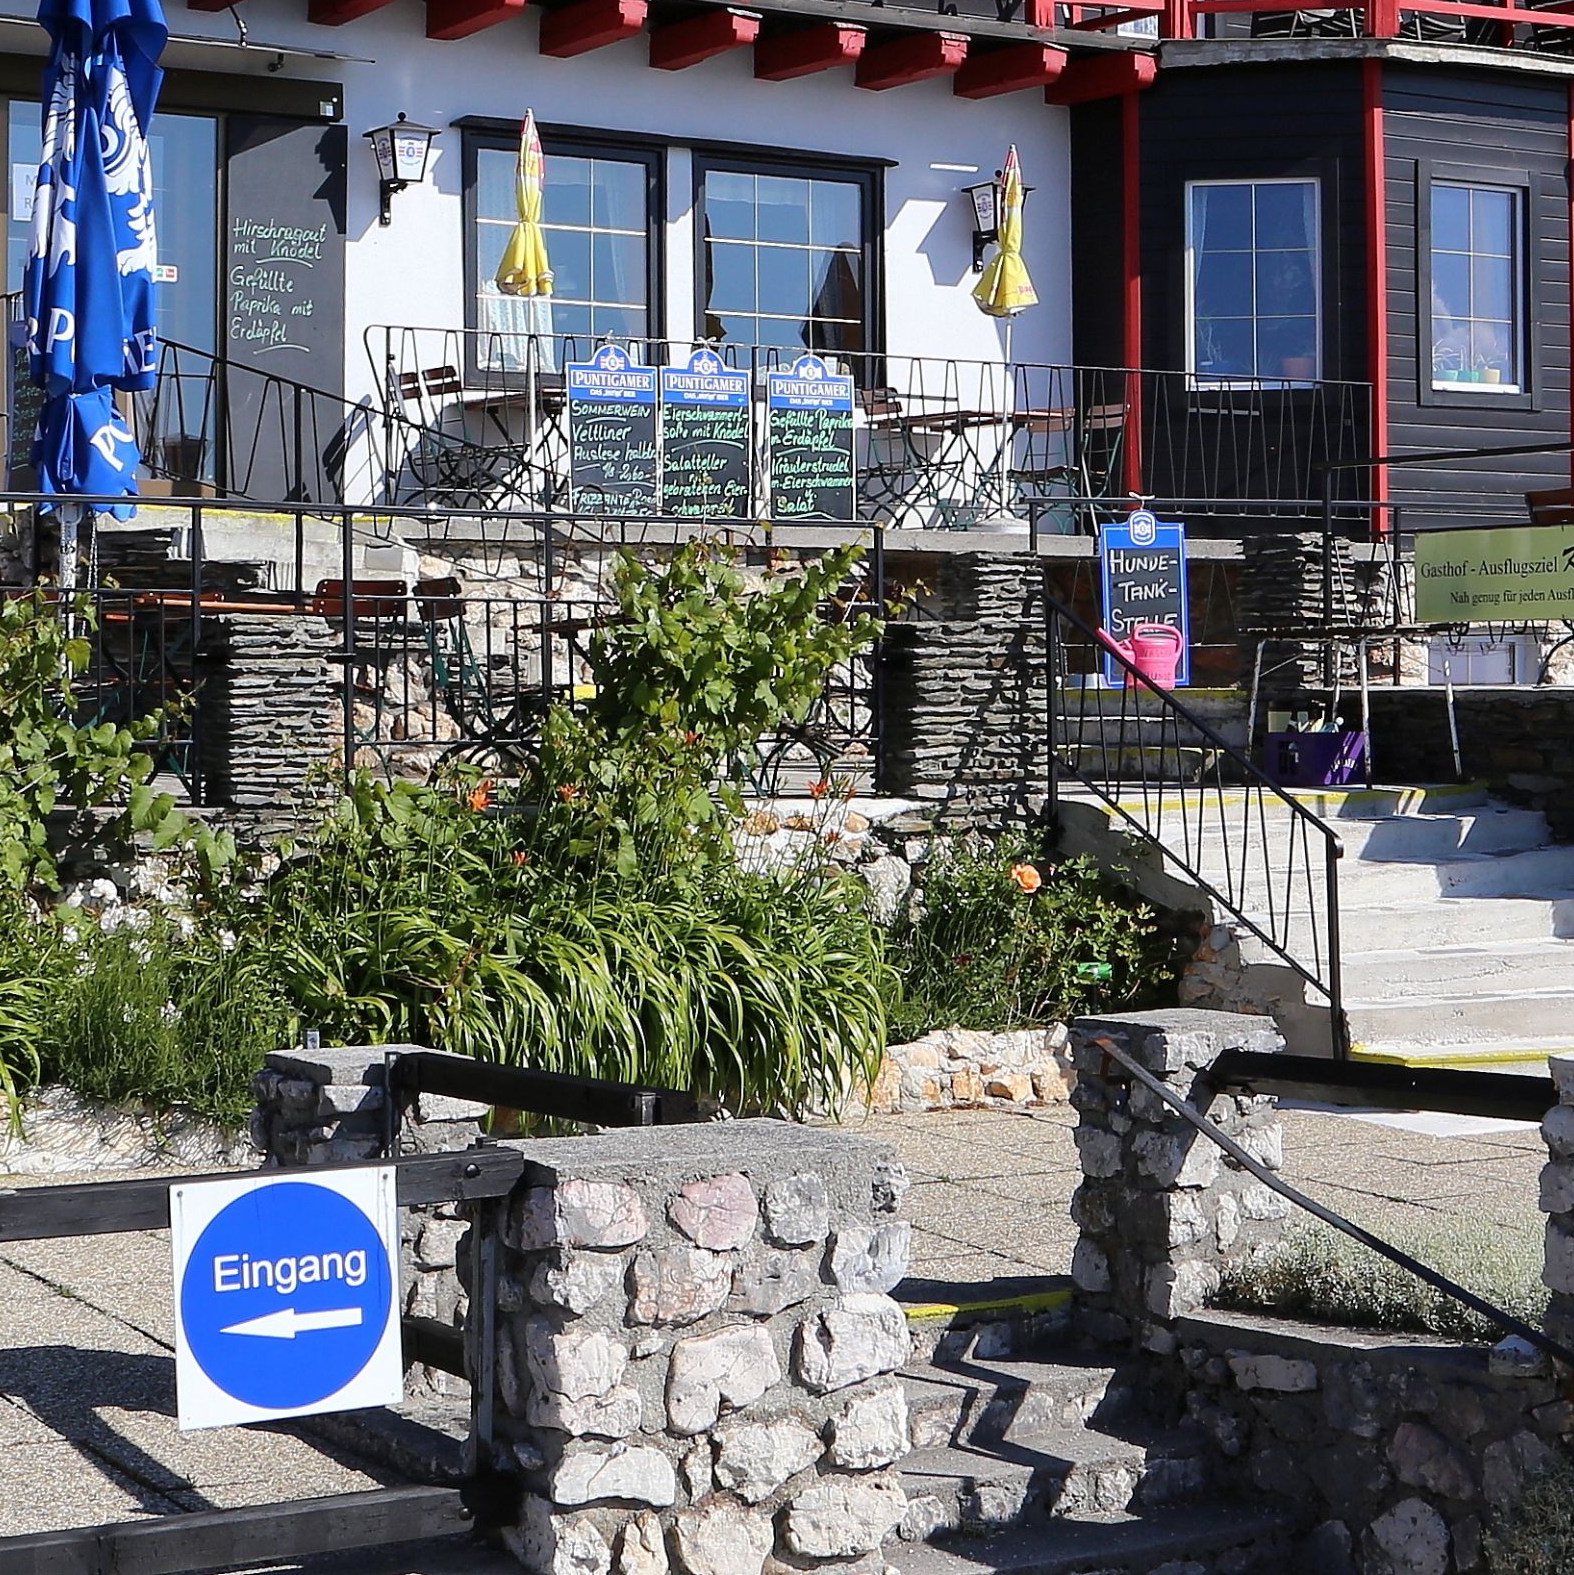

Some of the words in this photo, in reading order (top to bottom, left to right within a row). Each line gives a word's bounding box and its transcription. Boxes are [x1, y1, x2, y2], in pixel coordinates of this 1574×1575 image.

[233, 218, 326, 245] Hirschragout
[234, 238, 256, 254] mit
[270, 240, 322, 260] Knödel
[230, 266, 294, 295] Gefüllte
[230, 290, 281, 316] Paprika
[291, 299, 313, 316] mit
[230, 316, 287, 345] Erdäpfel
[575, 371, 650, 388] PUNTIGAMER
[669, 375, 743, 392] PUNTIGAMER
[775, 381, 847, 397] PUNTIGAMER
[572, 400, 650, 418] SOMMERWEIN
[769, 409, 814, 431] Gefüllte
[572, 424, 631, 442] Veltliner
[692, 423, 711, 438] mit
[713, 422, 749, 440] Knödel
[783, 429, 835, 452] Erdäpfel
[574, 443, 620, 461] Auslese
[664, 453, 728, 472] Salatteller
[772, 455, 849, 477] Kräuterstrudel
[777, 496, 814, 513] Salat
[1110, 549, 1178, 574] HUNDE-
[1421, 561, 1469, 578] Gasthof
[1479, 556, 1558, 578] Ausflugsziel
[1118, 578, 1177, 602] TANK-
[1450, 591, 1470, 604] Nah
[1472, 592, 1500, 606] genug
[1502, 589, 1518, 602] für
[1518, 589, 1546, 605] jeden
[213, 1250, 367, 1294] Eingang
